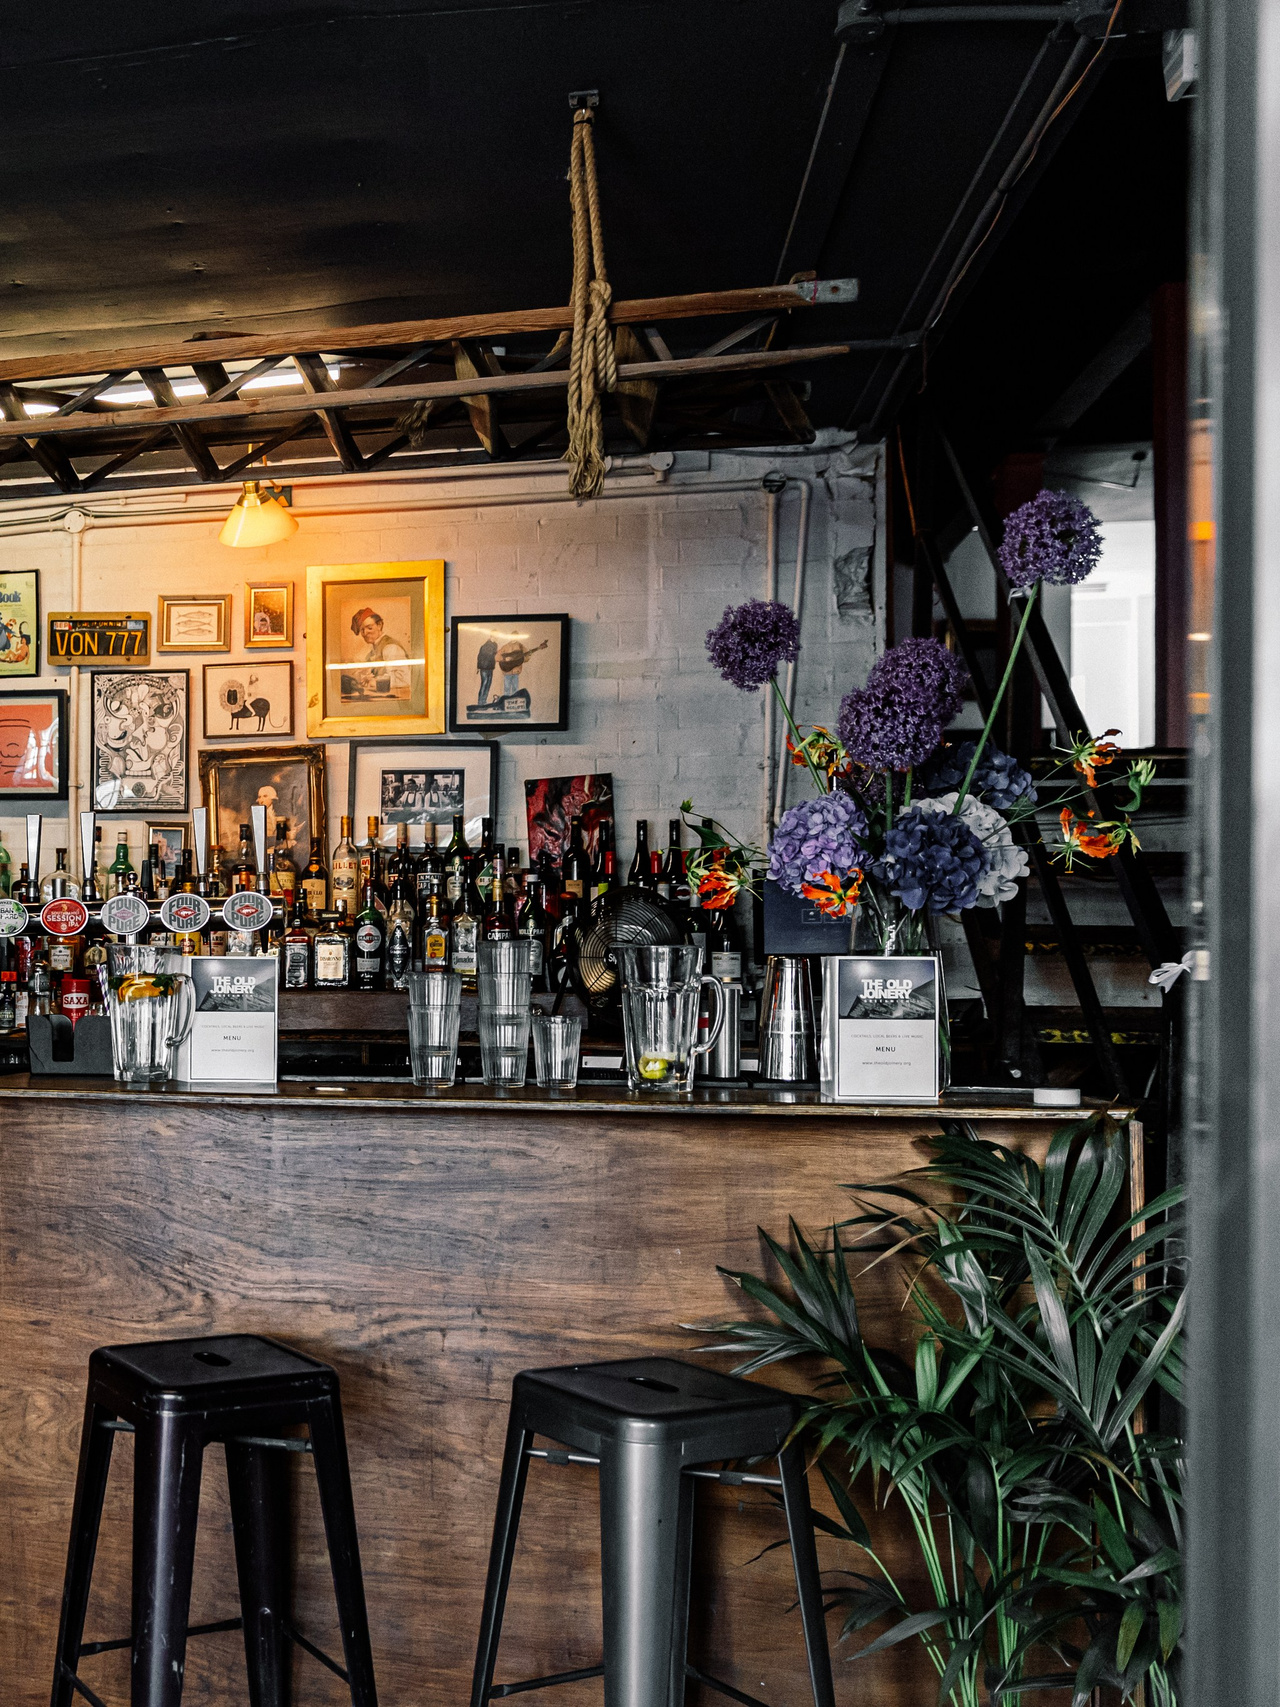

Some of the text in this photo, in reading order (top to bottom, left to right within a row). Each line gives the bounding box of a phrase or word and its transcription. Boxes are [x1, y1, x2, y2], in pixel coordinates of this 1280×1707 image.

[56, 632, 142, 655] VON 777
[108, 898, 140, 914] FOUR
[169, 897, 200, 914] FOUR
[231, 895, 264, 911] FOUR
[108, 914, 140, 931] PURE
[169, 913, 200, 929] PURE
[231, 910, 264, 927] PURE
[211, 976, 256, 985] THE OLD
[861, 979, 913, 989] THE OLD
[210, 984, 256, 994] JOINERY
[859, 988, 913, 999] JOINERY
[64, 996, 88, 1005] SAXA
